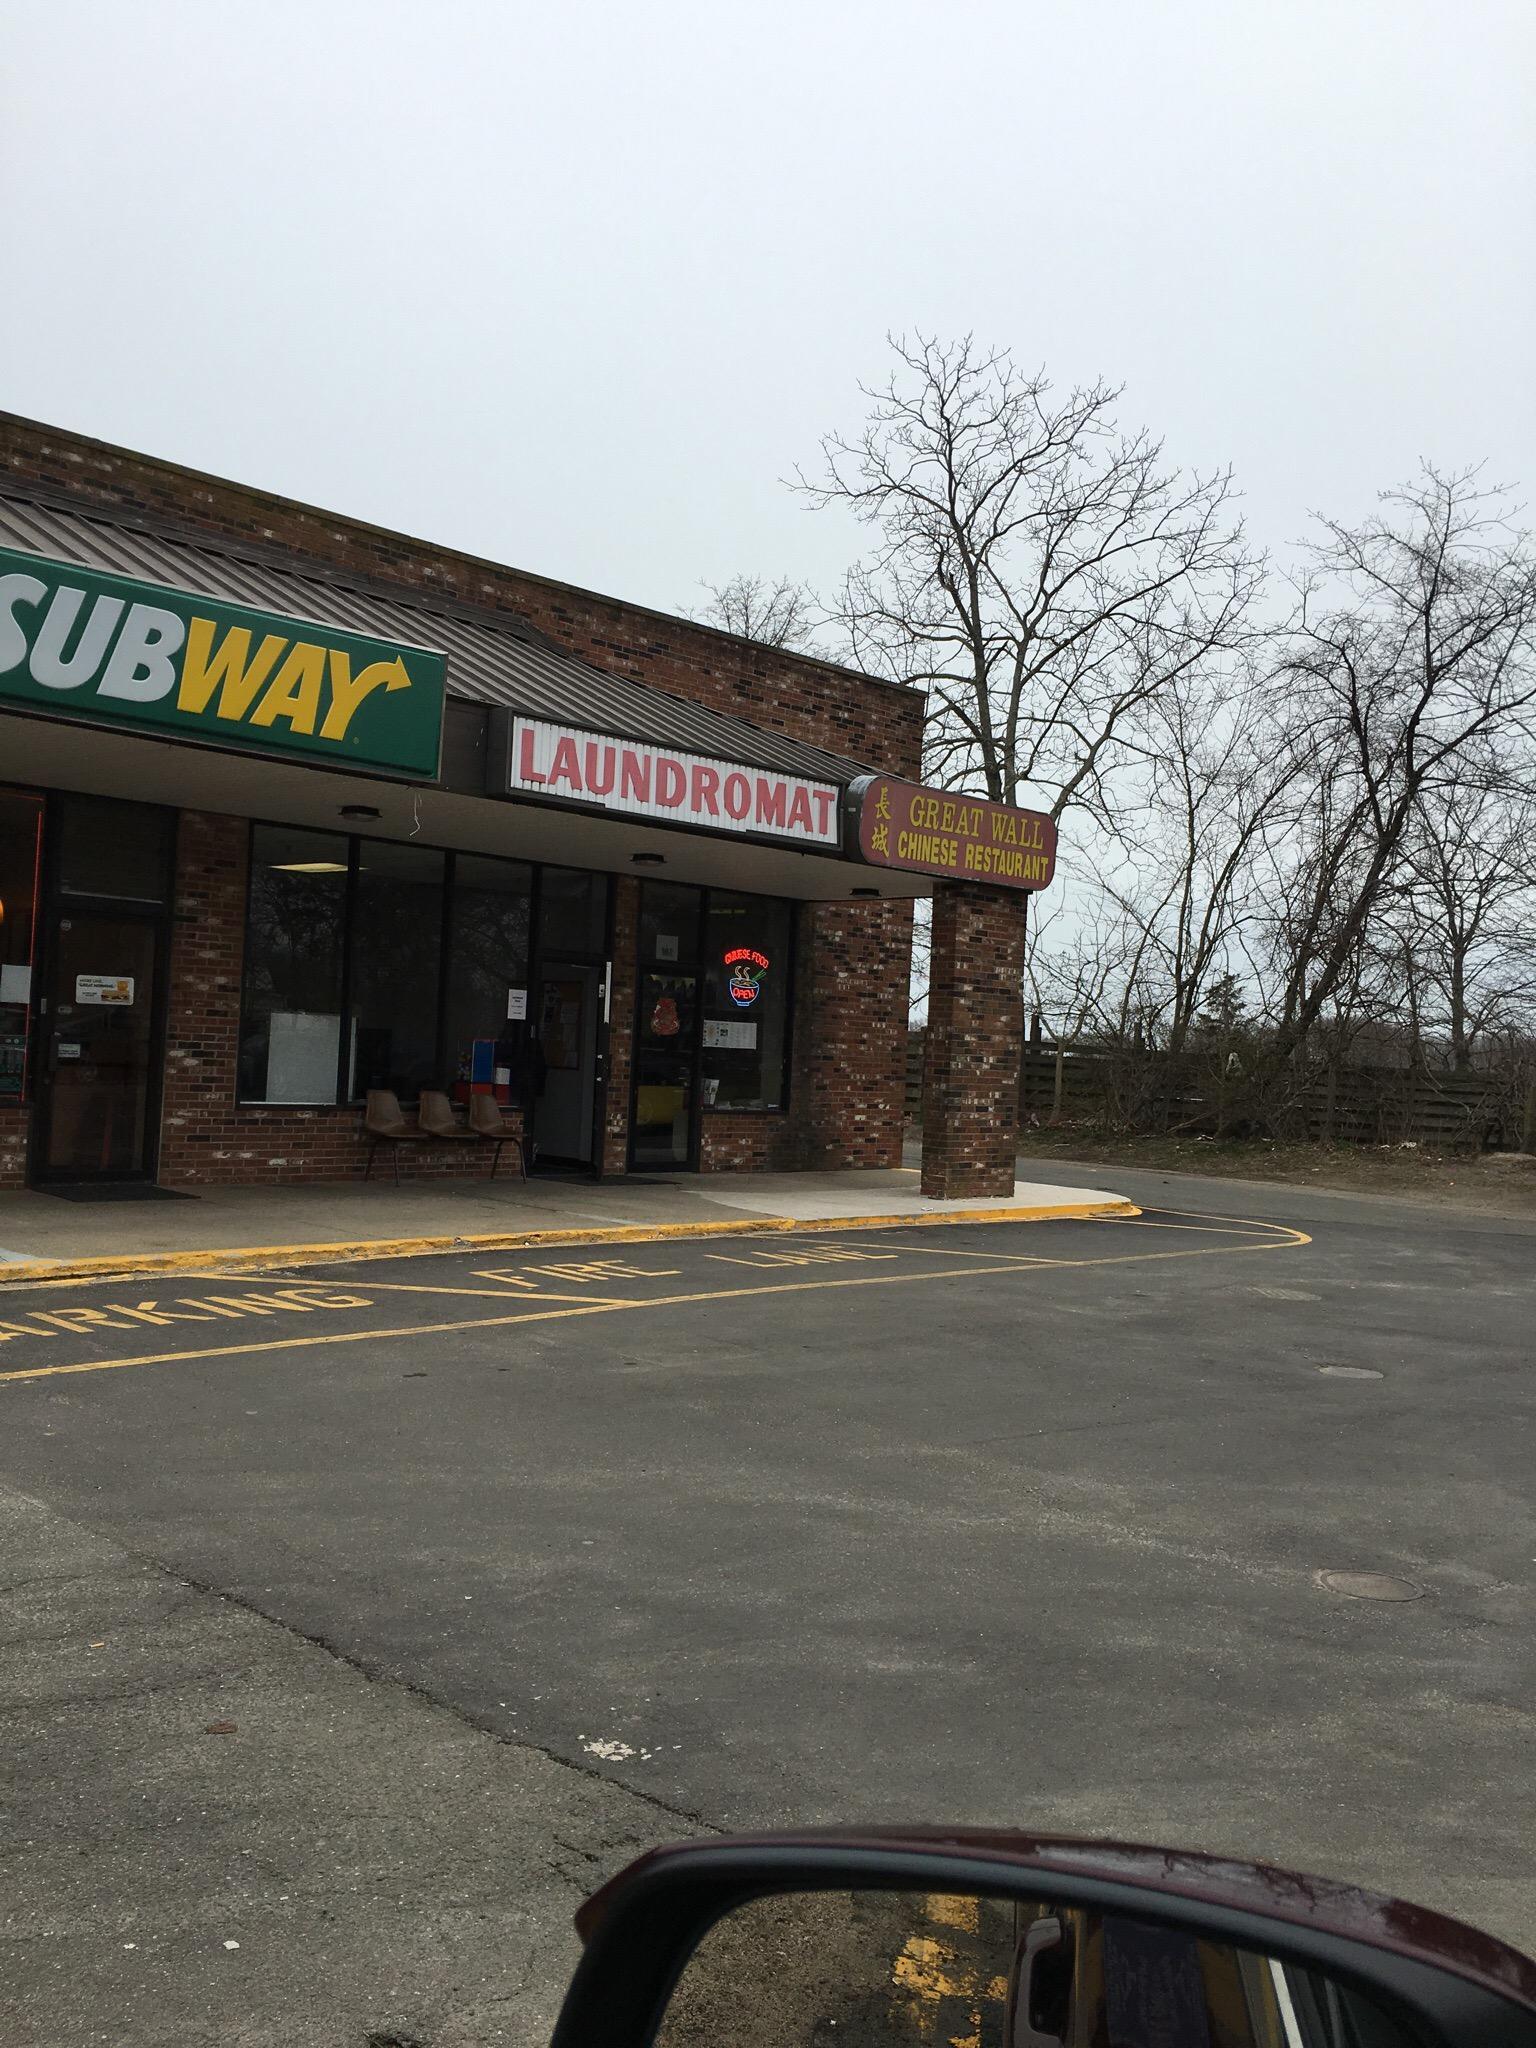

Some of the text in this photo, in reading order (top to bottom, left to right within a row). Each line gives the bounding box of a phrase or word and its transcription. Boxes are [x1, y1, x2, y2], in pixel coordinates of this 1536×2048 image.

[0, 573, 412, 741] SUBWAY
[520, 728, 835, 835] LAUNDROMAT
[871, 785, 891, 858] 長城
[909, 795, 1044, 849] GREAT WALL
[898, 831, 1048, 881] CHINESE RESTAURANT
[751, 951, 769, 968] FOOD
[733, 987, 755, 999] OPEN
[469, 1259, 683, 1288] FIRE
[704, 1246, 899, 1268] LANE
